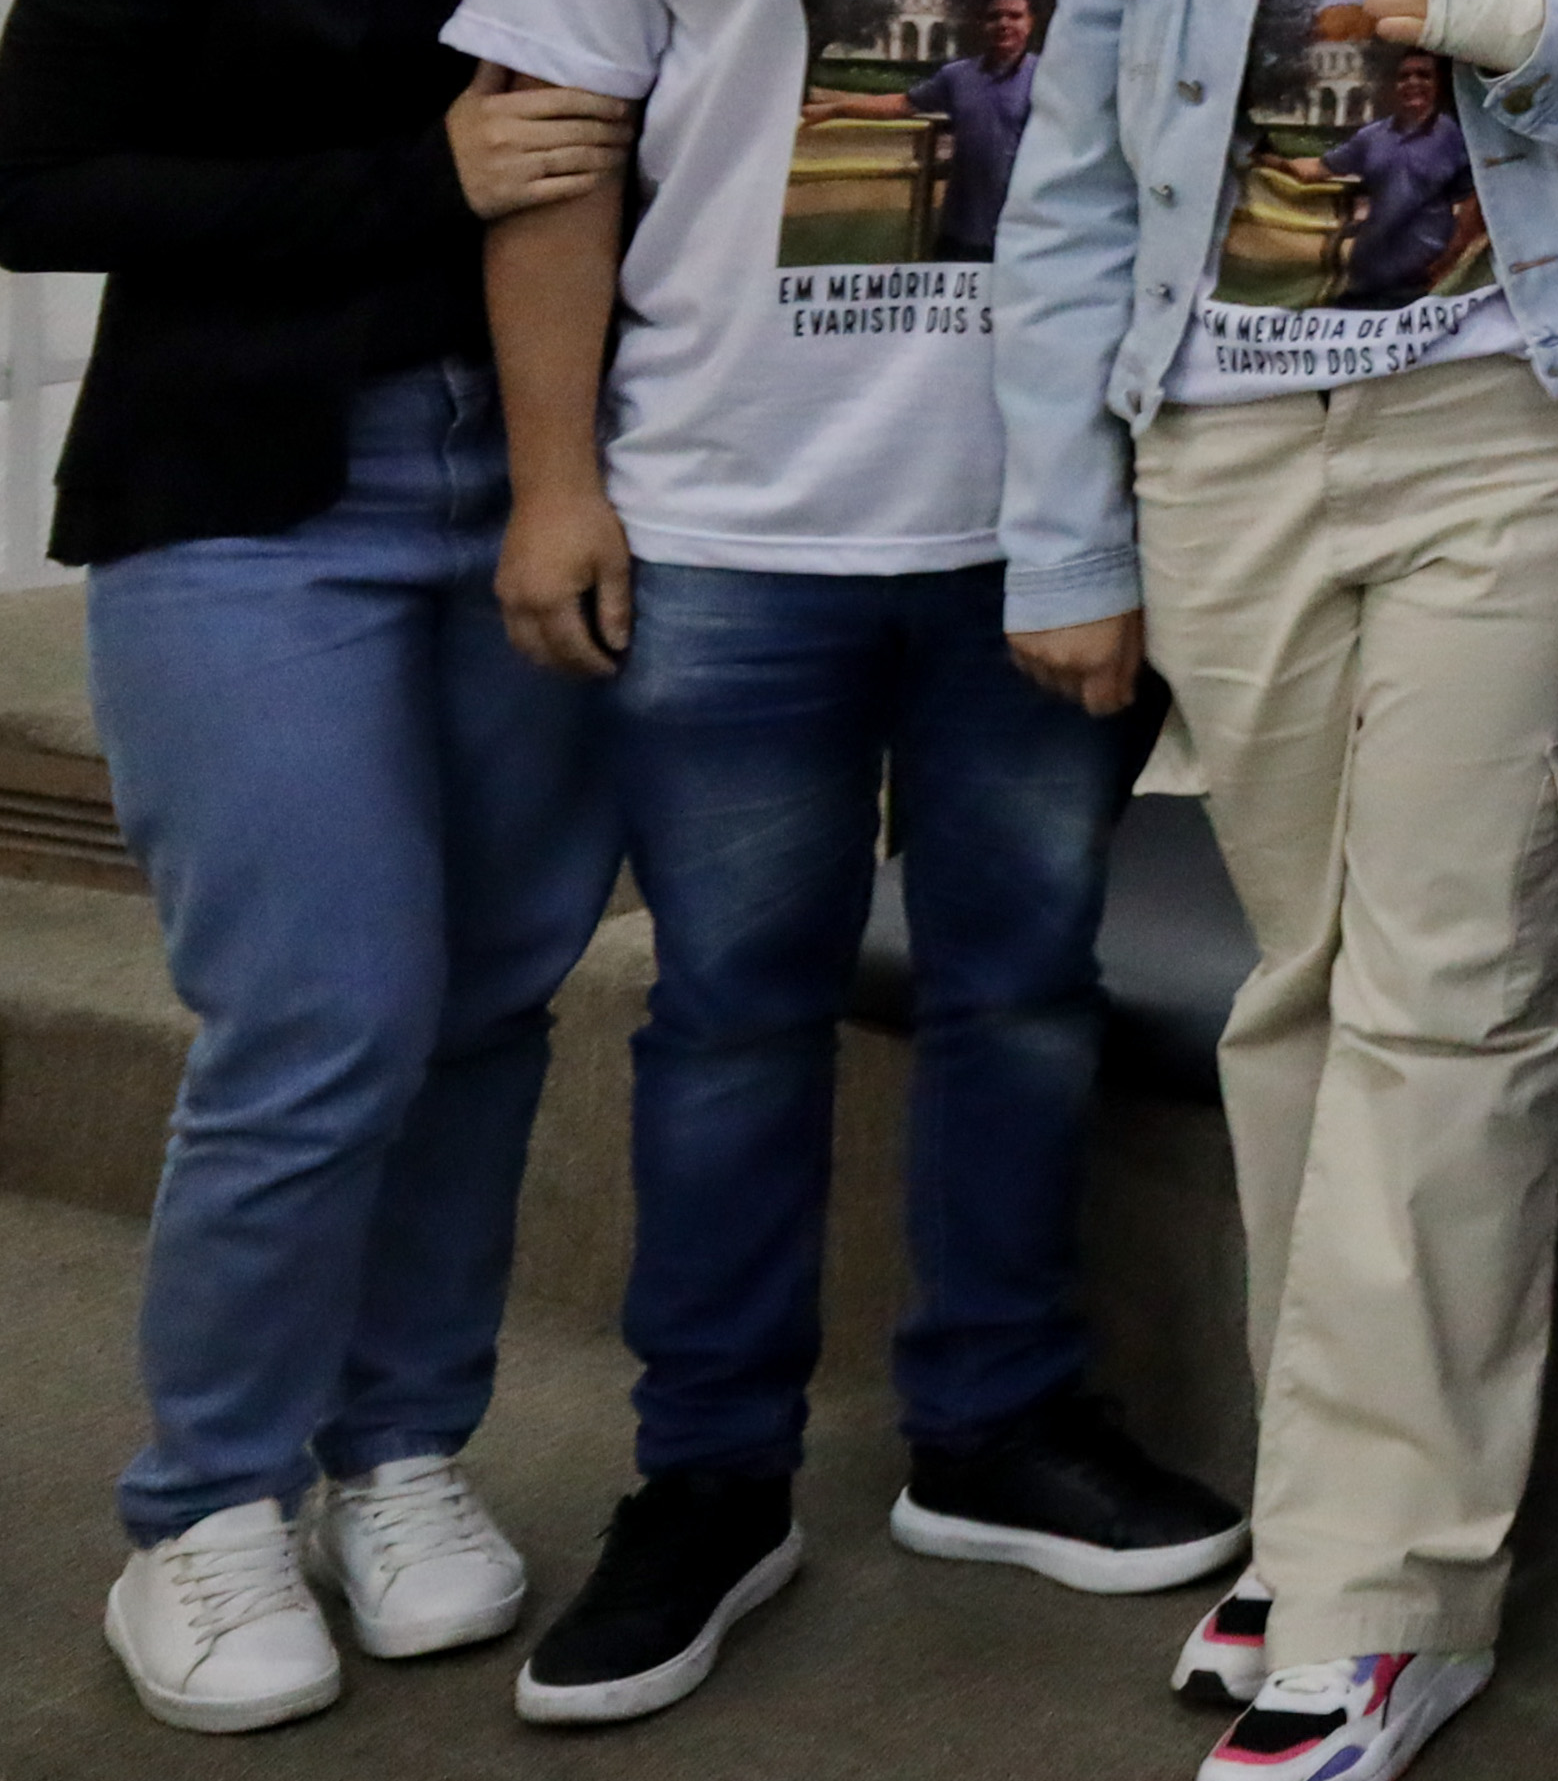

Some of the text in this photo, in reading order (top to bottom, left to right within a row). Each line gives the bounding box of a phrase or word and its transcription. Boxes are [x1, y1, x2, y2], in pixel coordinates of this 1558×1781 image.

[778, 266, 979, 304] EM MEMÓRIA DE
[794, 305, 915, 338] EVARISTO
[1357, 316, 1389, 340] DE
[1327, 346, 1374, 376] DOS
